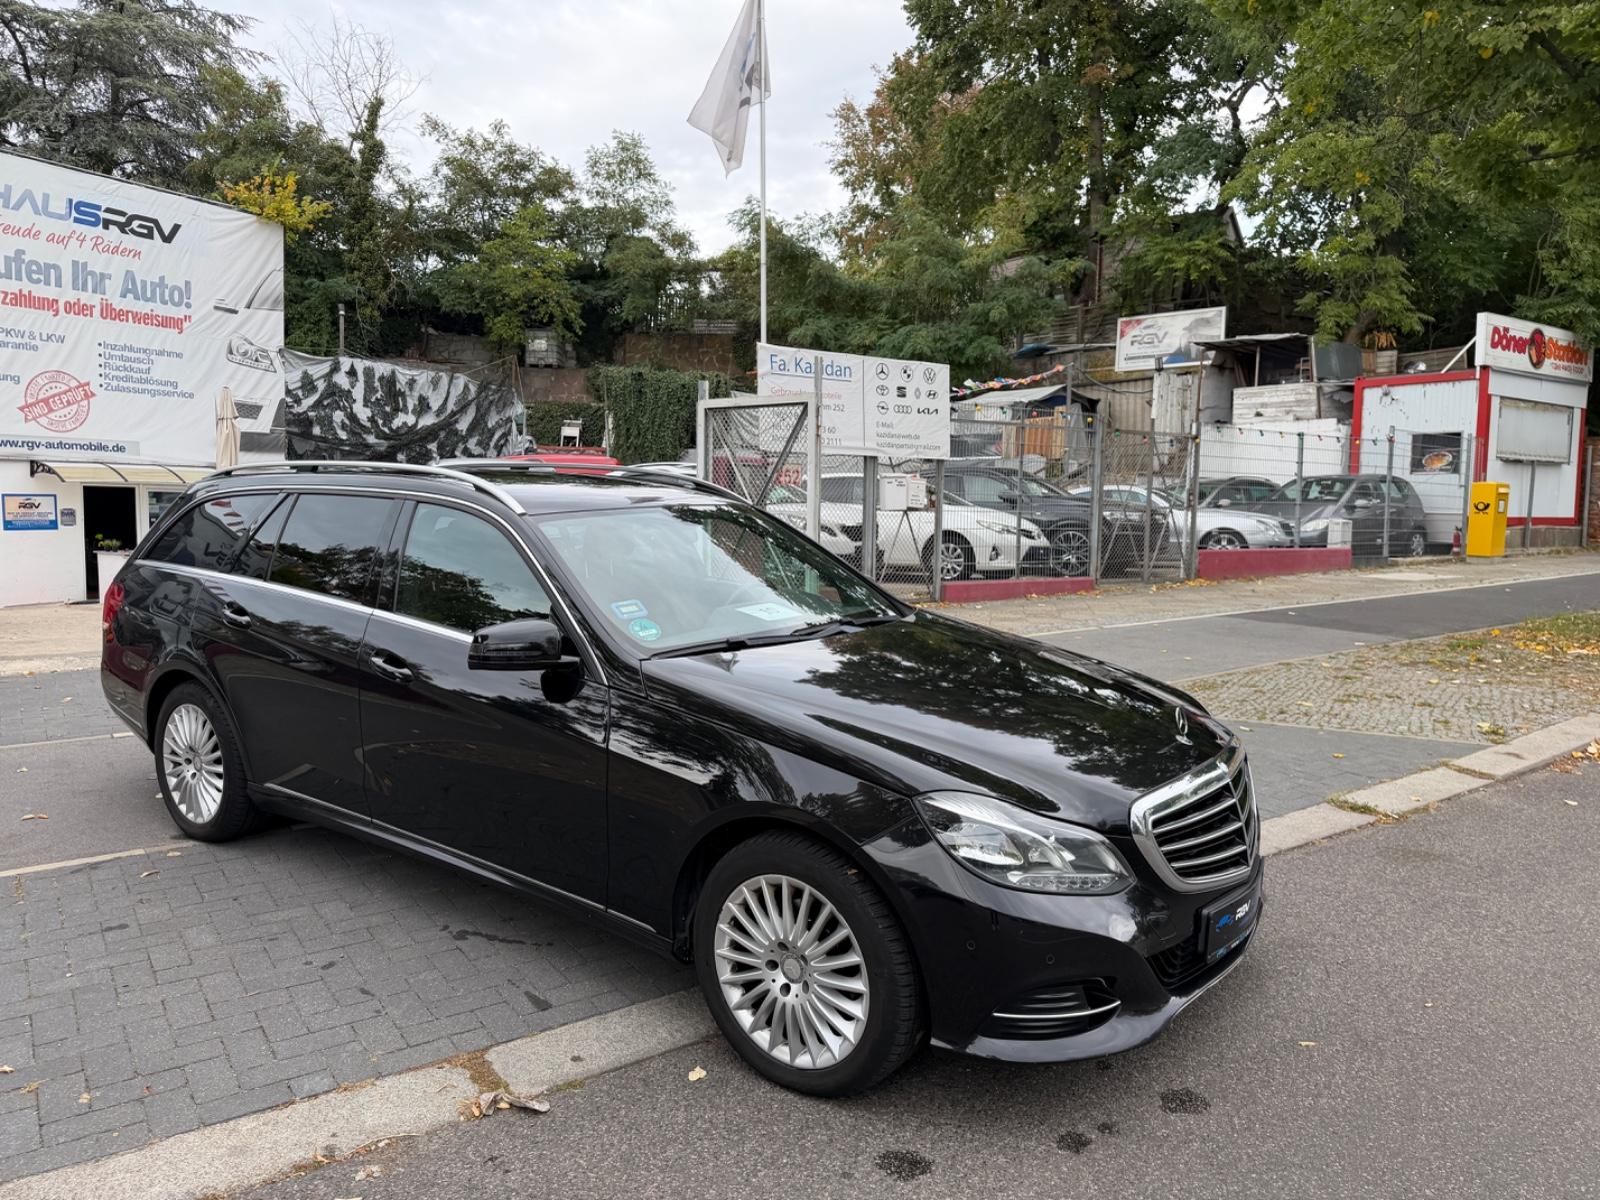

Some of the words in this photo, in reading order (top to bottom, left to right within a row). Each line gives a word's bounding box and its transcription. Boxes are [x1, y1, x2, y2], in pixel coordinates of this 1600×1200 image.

[46, 229, 76, 250] auf
[76, 232, 86, 249] 4
[90, 235, 142, 260] Rädern
[72, 259, 112, 295] Ihr
[120, 269, 192, 309] Auto!
[0, 288, 59, 317] zahlung
[64, 297, 95, 318] oder
[28, 330, 37, 341] &
[39, 332, 66, 344] LKW
[1490, 326, 1530, 355] Döner
[103, 351, 154, 366] Umtausch
[770, 353, 790, 372] Fa.
[794, 356, 852, 378] Kaidan
[103, 361, 151, 375] Rückkauf
[104, 372, 178, 389] Kreditablösung
[104, 382, 195, 399] Zulassungsservice
[23, 402, 48, 419] SIND
[18, 502, 41, 510] RGV
